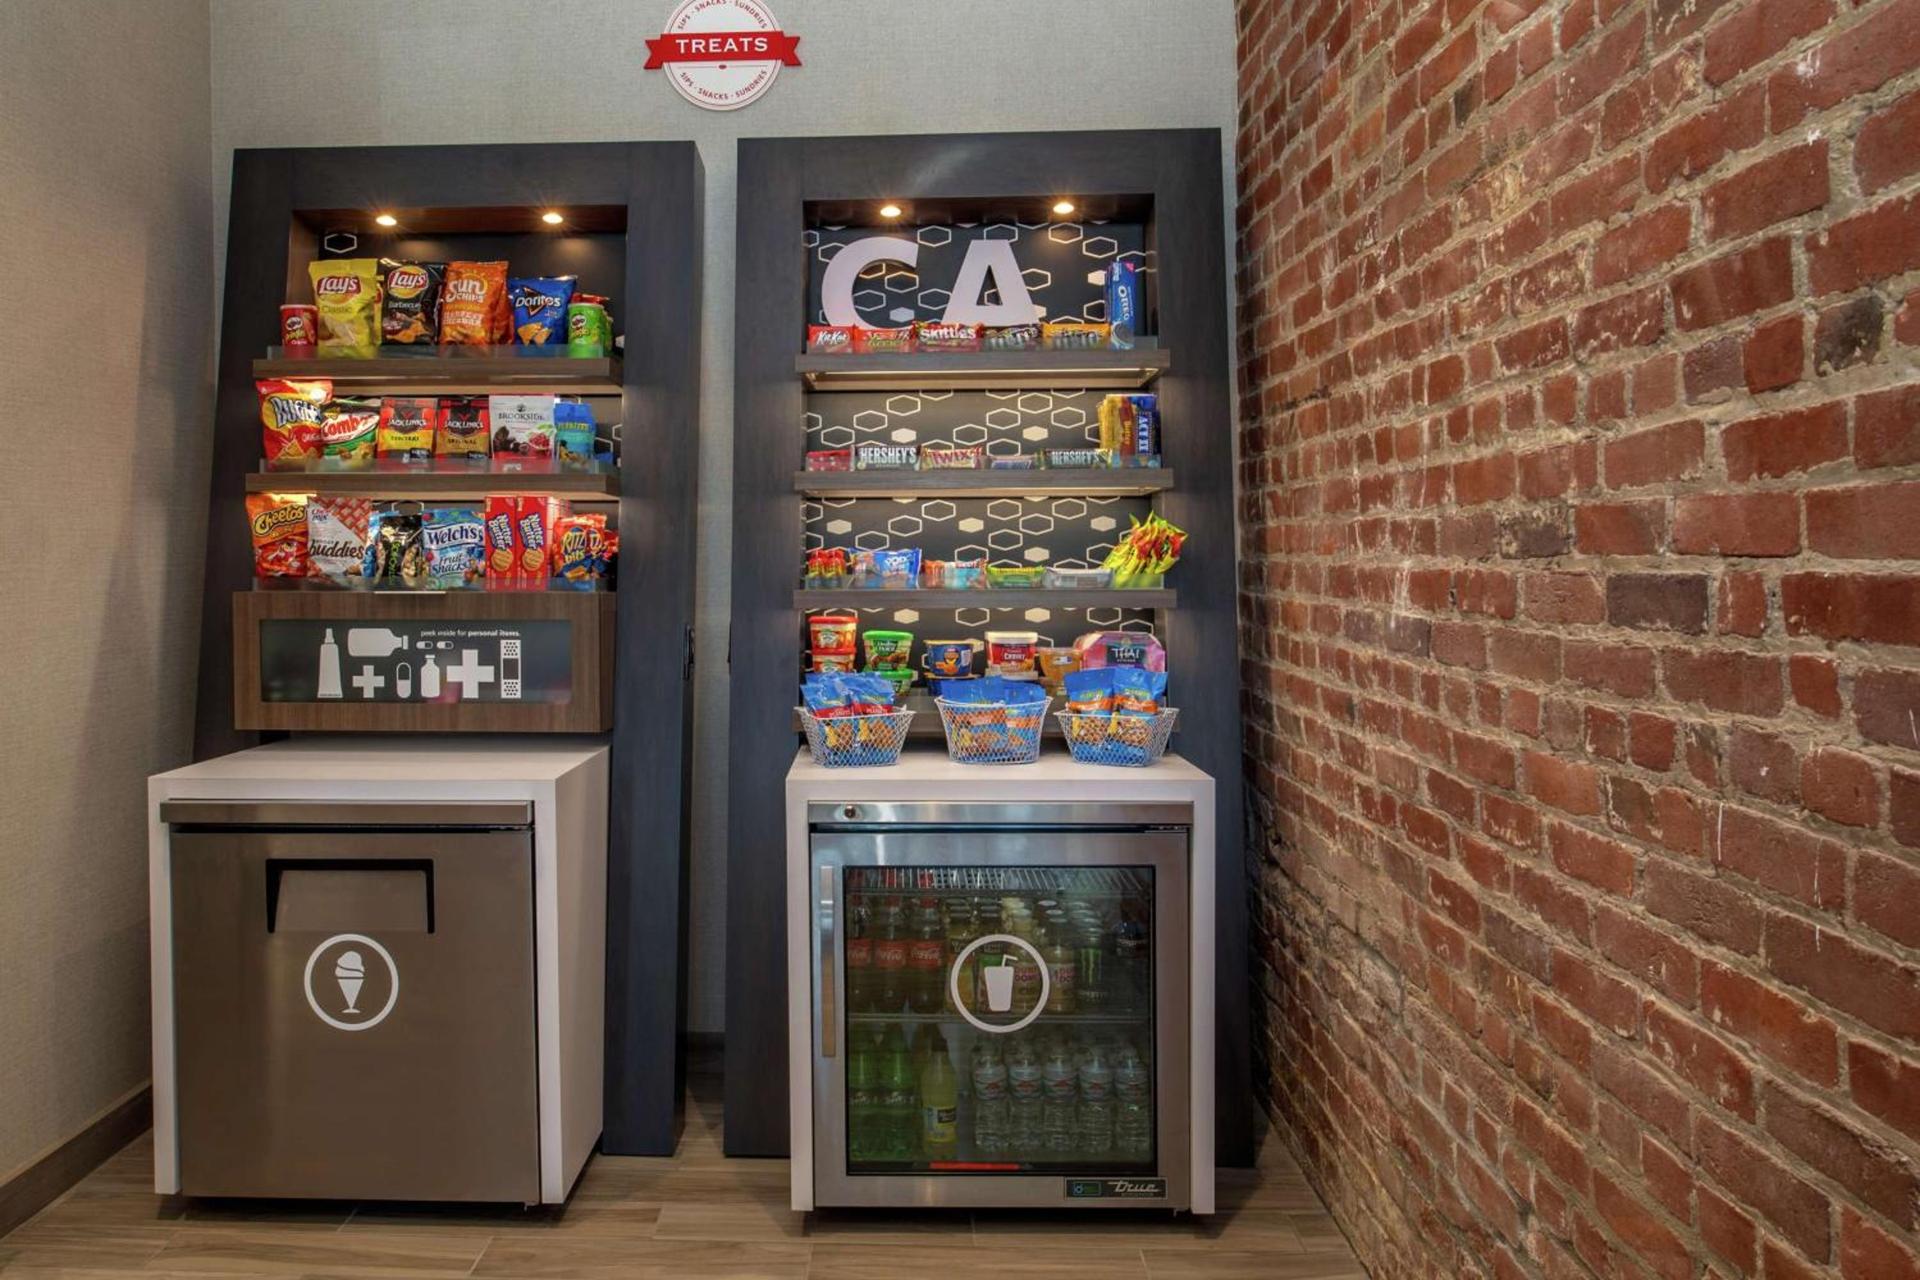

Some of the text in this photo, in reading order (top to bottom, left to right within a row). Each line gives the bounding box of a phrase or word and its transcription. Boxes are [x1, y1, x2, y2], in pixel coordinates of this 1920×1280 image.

[677, 14, 690, 30] SIPS
[735, 0, 767, 29] SUNDRIES
[675, 37, 769, 54] TREATS
[680, 70, 767, 100] SIPS SNACKS SUNDRIES
[515, 295, 561, 307] Doritos
[1118, 285, 1130, 321] OREO
[860, 447, 917, 464] HERSHEY'S
[255, 506, 305, 534] Cheetos
[427, 526, 478, 546] Welch's
[309, 539, 364, 560] buddies
[421, 630, 436, 638] peek
[457, 629, 467, 637] for
[468, 630, 498, 638] personal
[1112, 648, 1140, 659] THAI
[1107, 1181, 1159, 1193] True
